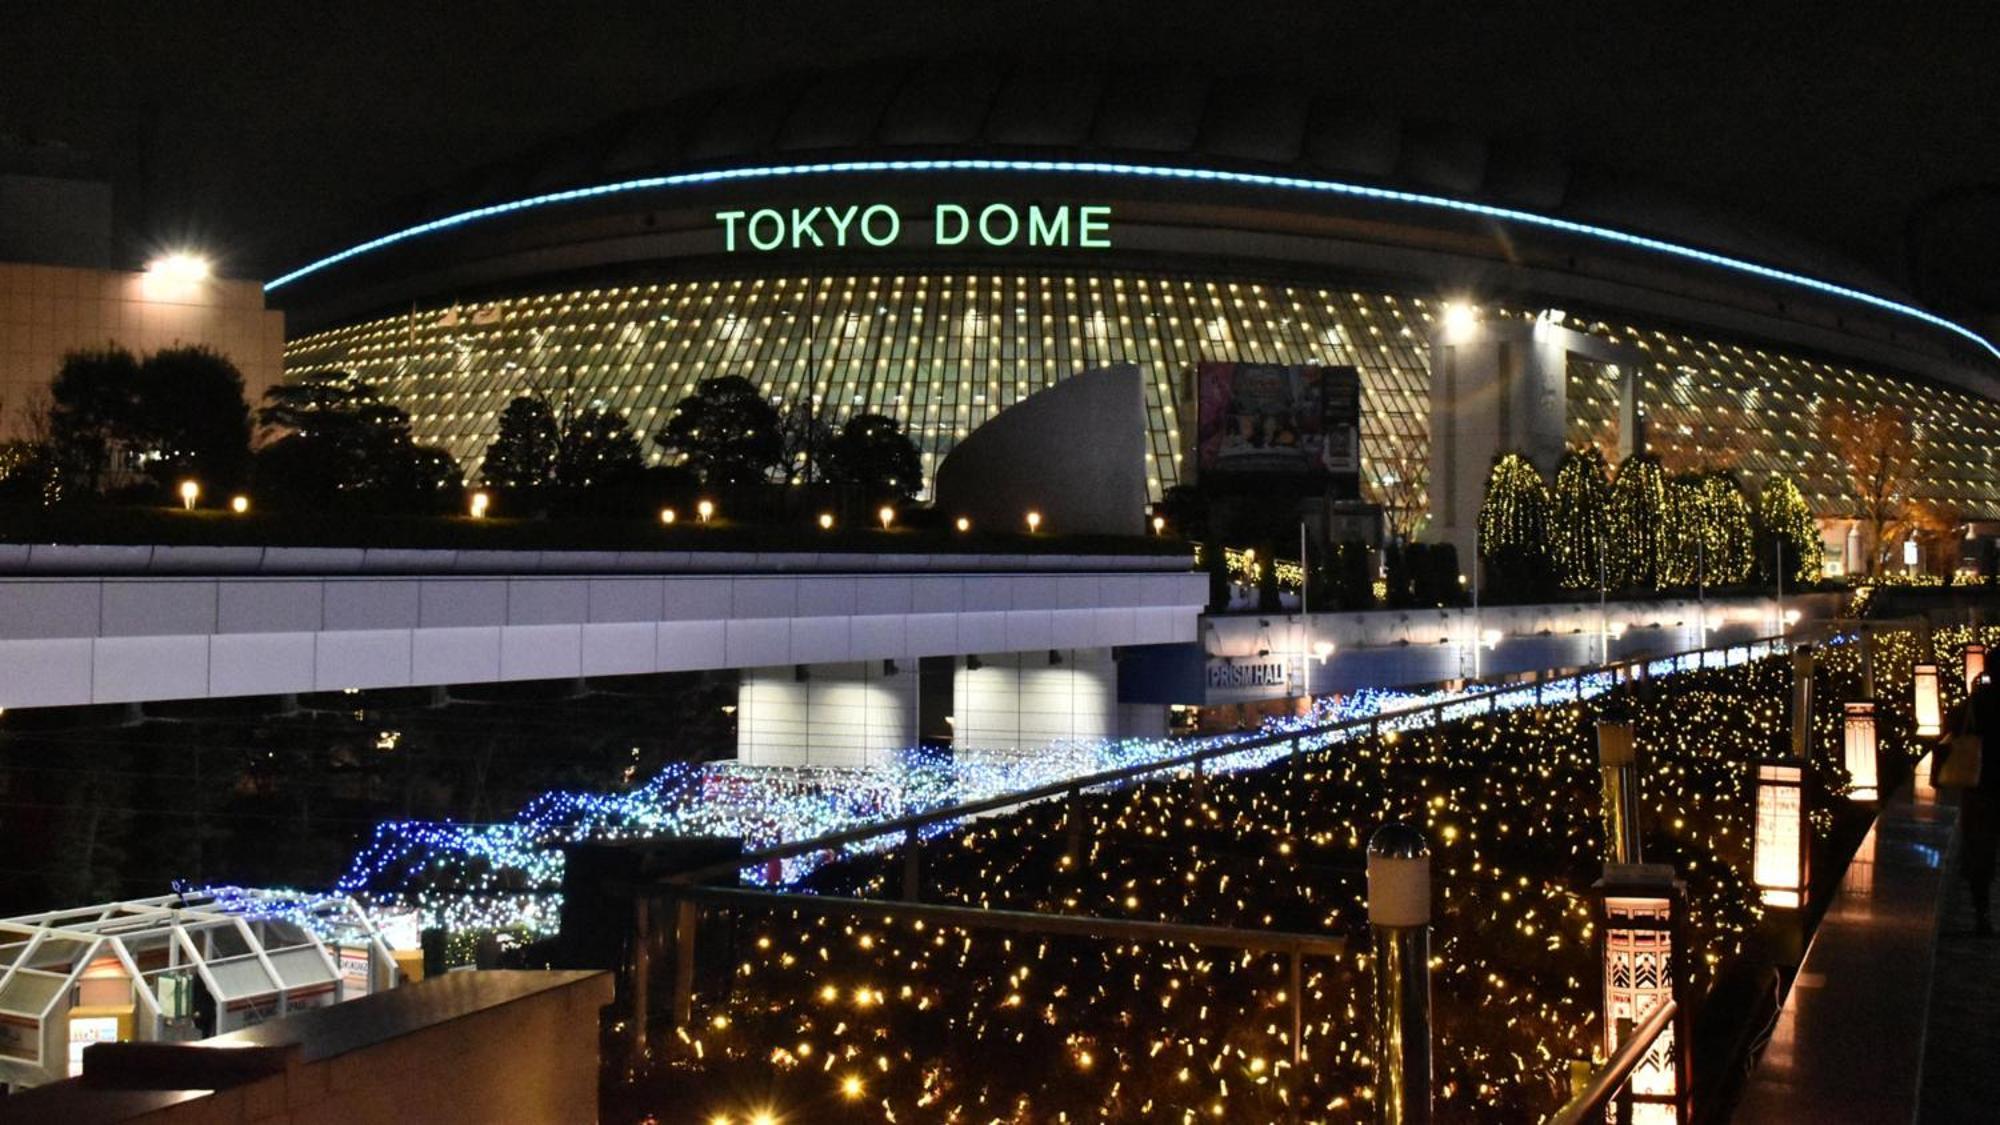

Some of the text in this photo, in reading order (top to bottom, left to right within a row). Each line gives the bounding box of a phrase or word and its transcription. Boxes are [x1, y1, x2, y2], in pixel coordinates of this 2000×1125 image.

[715, 204, 1112, 251] TOKYO DOME
[1209, 664, 1284, 688] PRISM HALL
